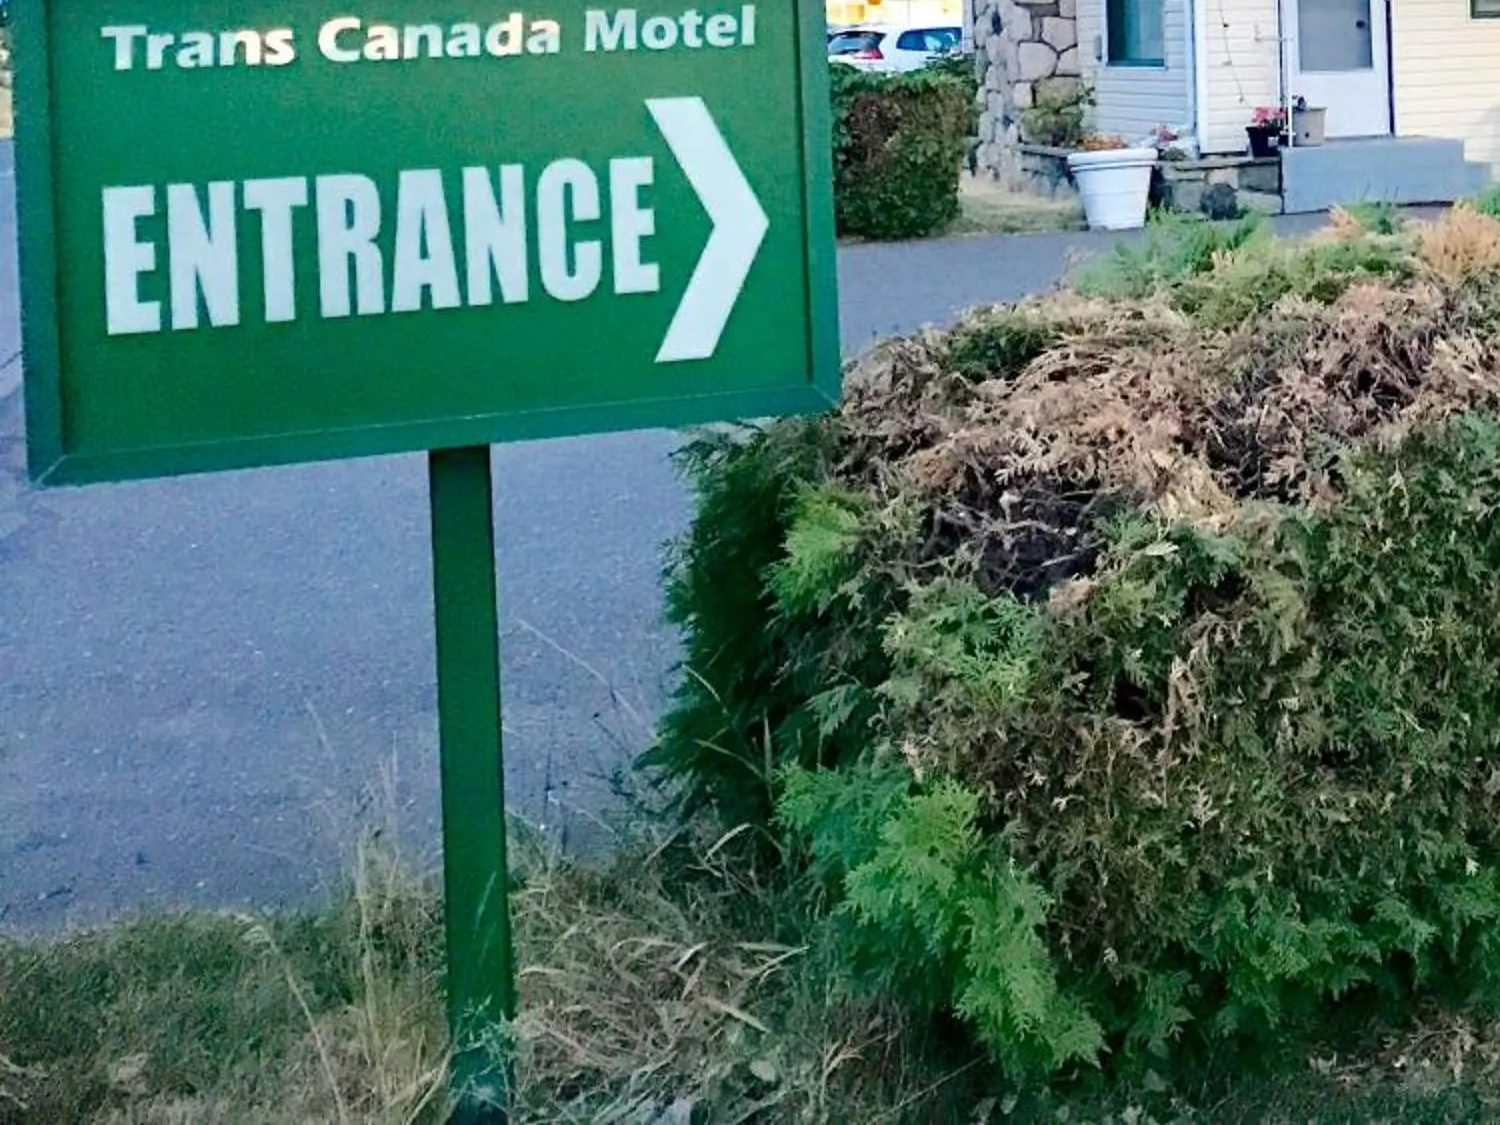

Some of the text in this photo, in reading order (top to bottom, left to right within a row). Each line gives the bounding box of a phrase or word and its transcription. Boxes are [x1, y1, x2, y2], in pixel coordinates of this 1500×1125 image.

[100, 5, 756, 70] Trans Canada Motel
[102, 157, 660, 335] ENTRANCE
